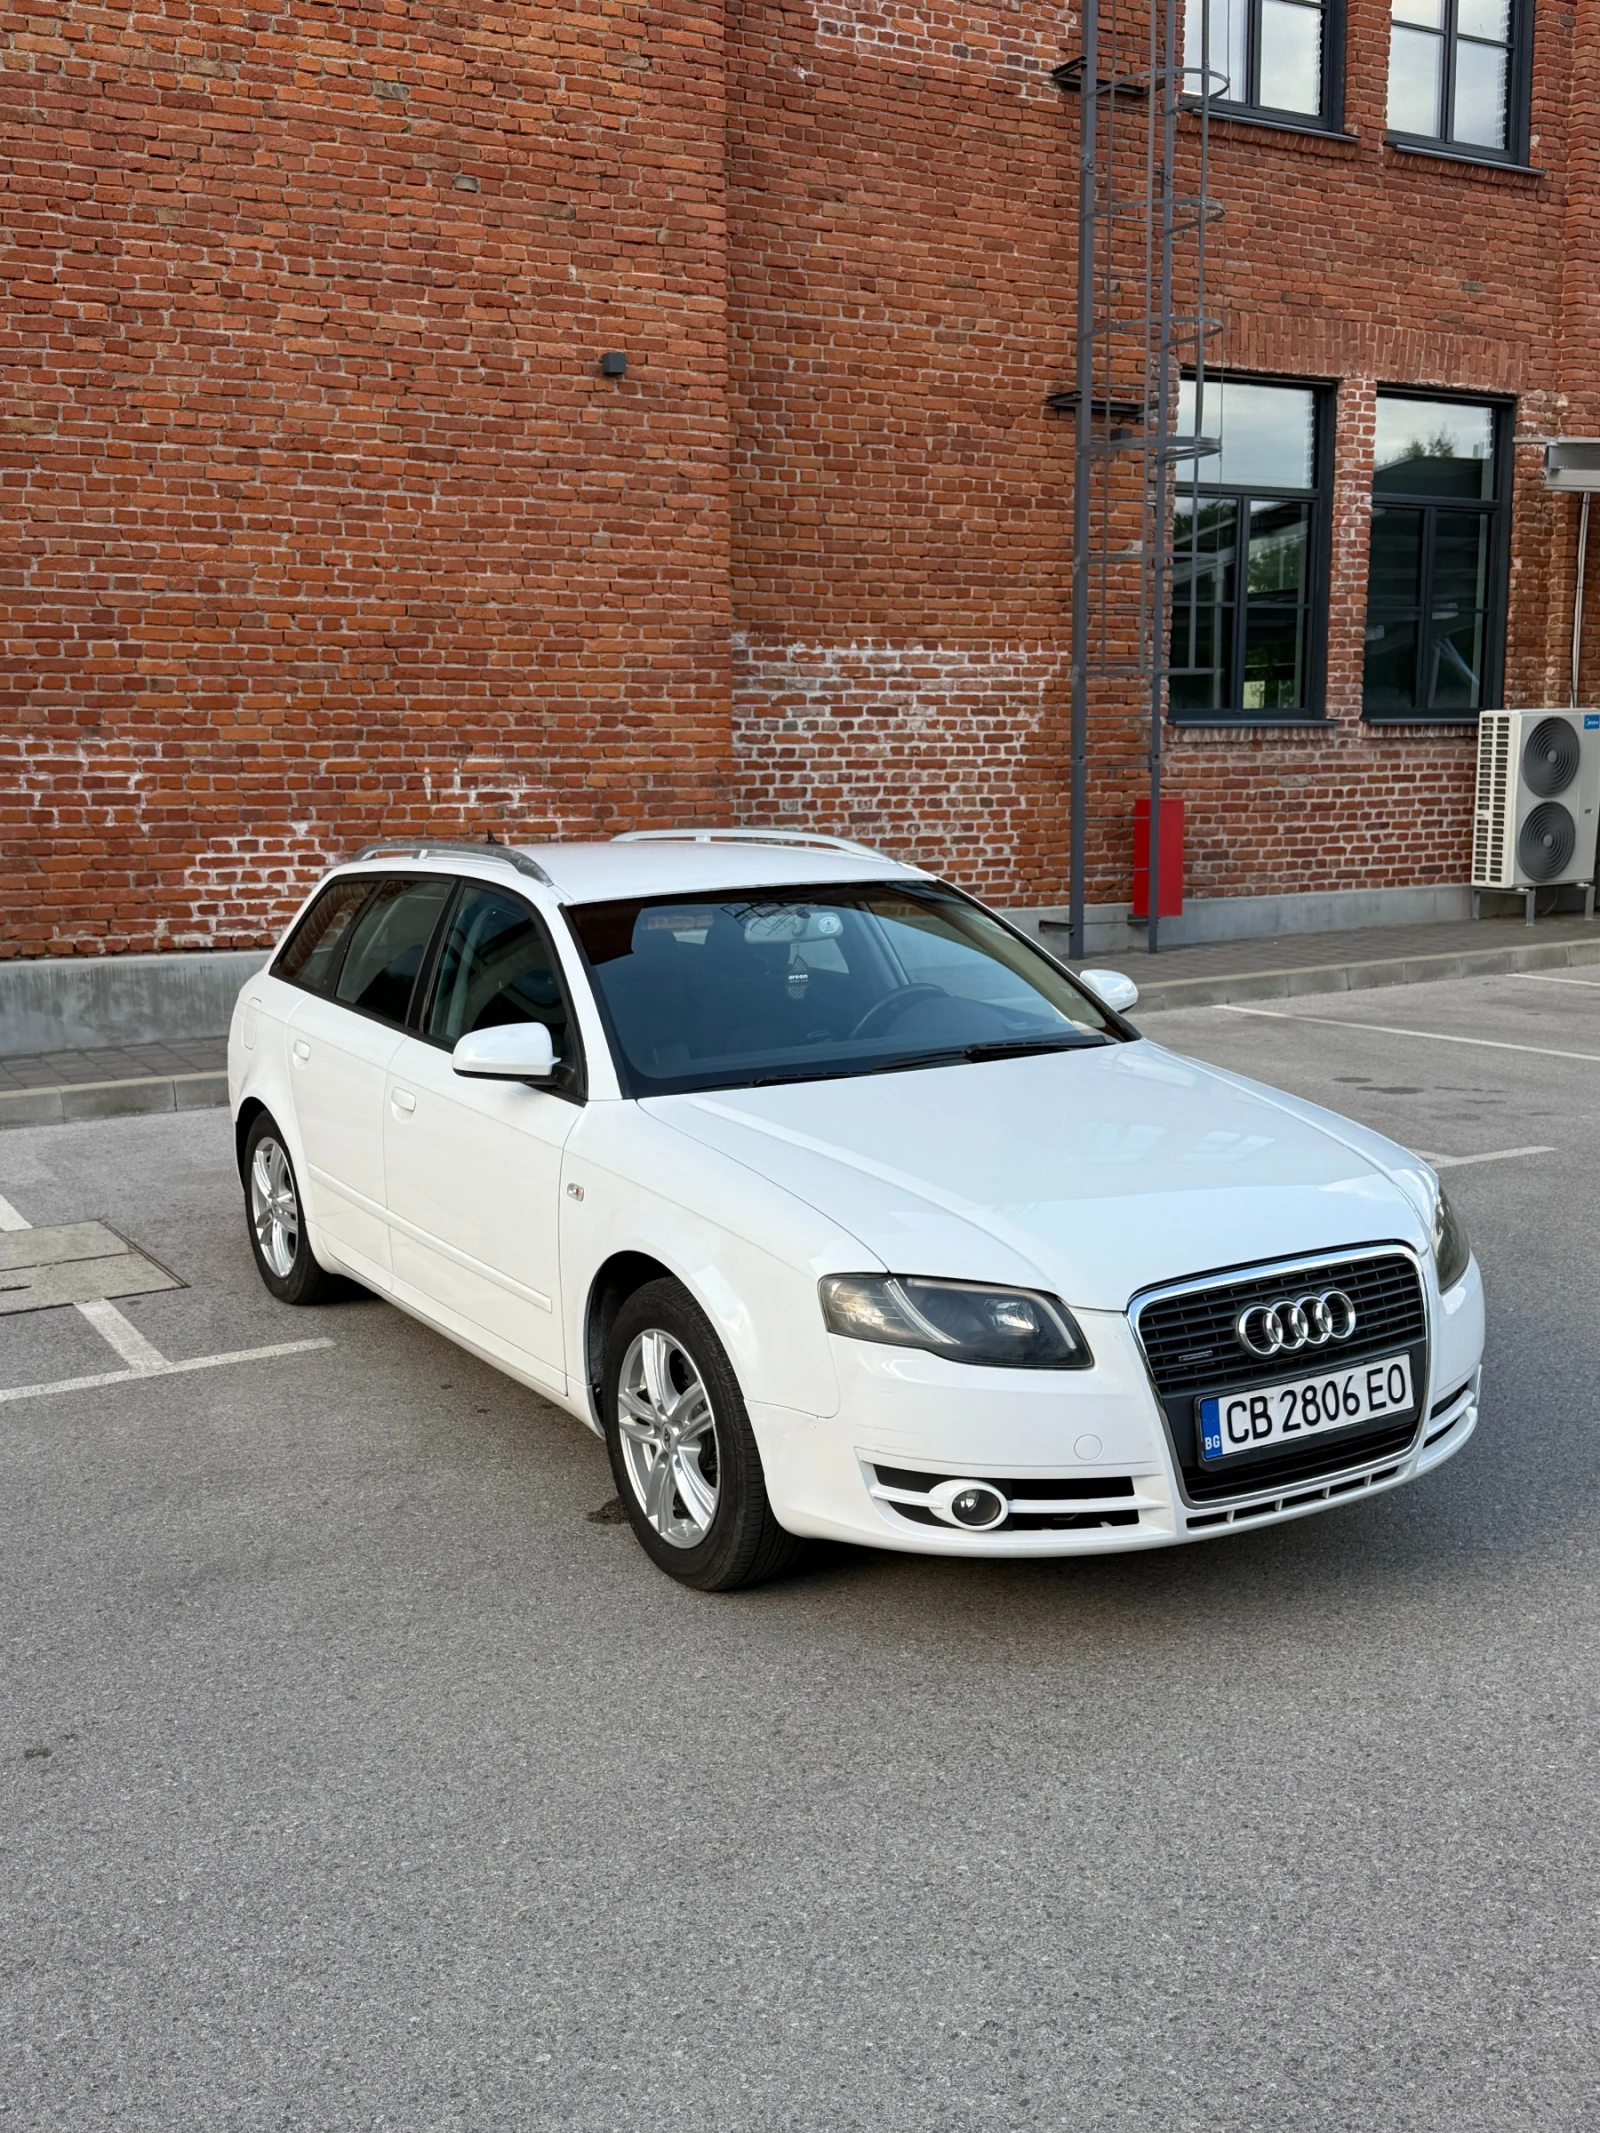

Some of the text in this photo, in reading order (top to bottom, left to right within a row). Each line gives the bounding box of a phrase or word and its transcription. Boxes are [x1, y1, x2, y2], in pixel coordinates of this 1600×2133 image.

[1226, 1363, 1405, 1443] CB 2806 EO
[1204, 1436, 1220, 1450] BG
